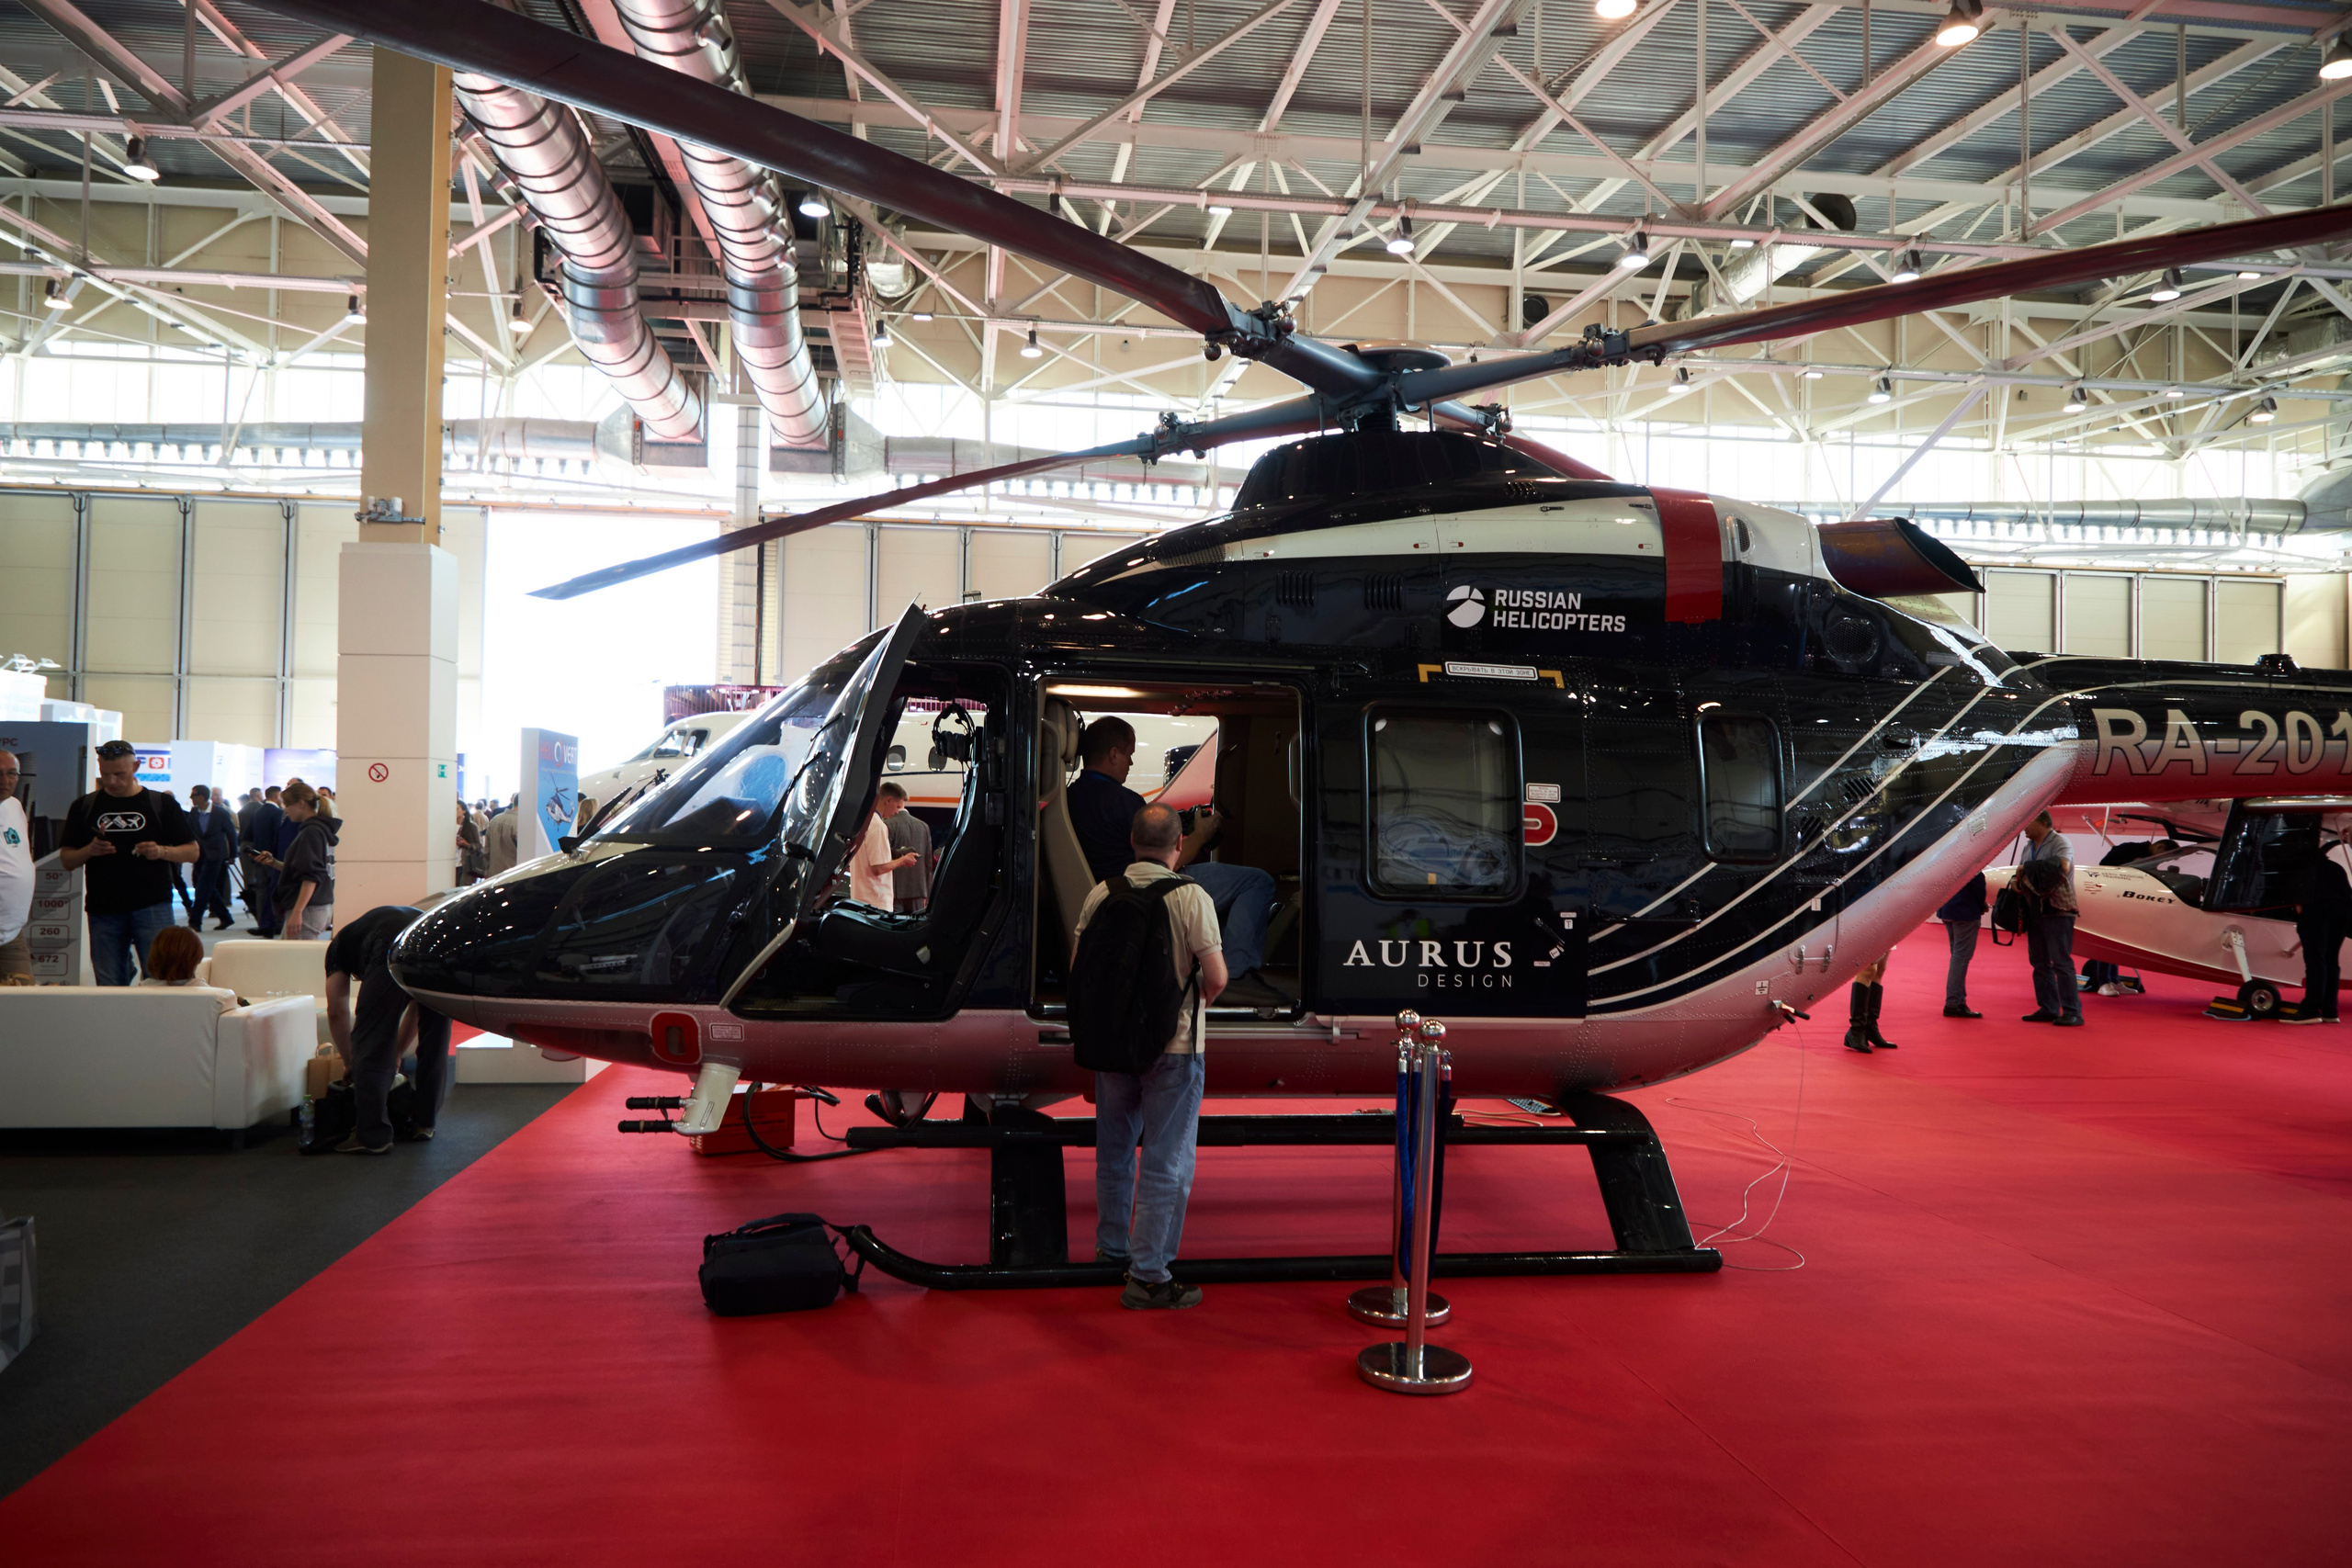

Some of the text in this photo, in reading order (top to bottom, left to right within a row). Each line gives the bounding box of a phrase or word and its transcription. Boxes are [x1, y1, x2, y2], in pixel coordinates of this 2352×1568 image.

[1495, 589, 1581, 610] RUSSIAN
[1493, 610, 1626, 633] HELICOPTERS
[40, 927, 61, 936] 260
[38, 954, 59, 964] 672
[1342, 940, 1512, 968] AURUS
[1418, 974, 1512, 987] DESIGN
